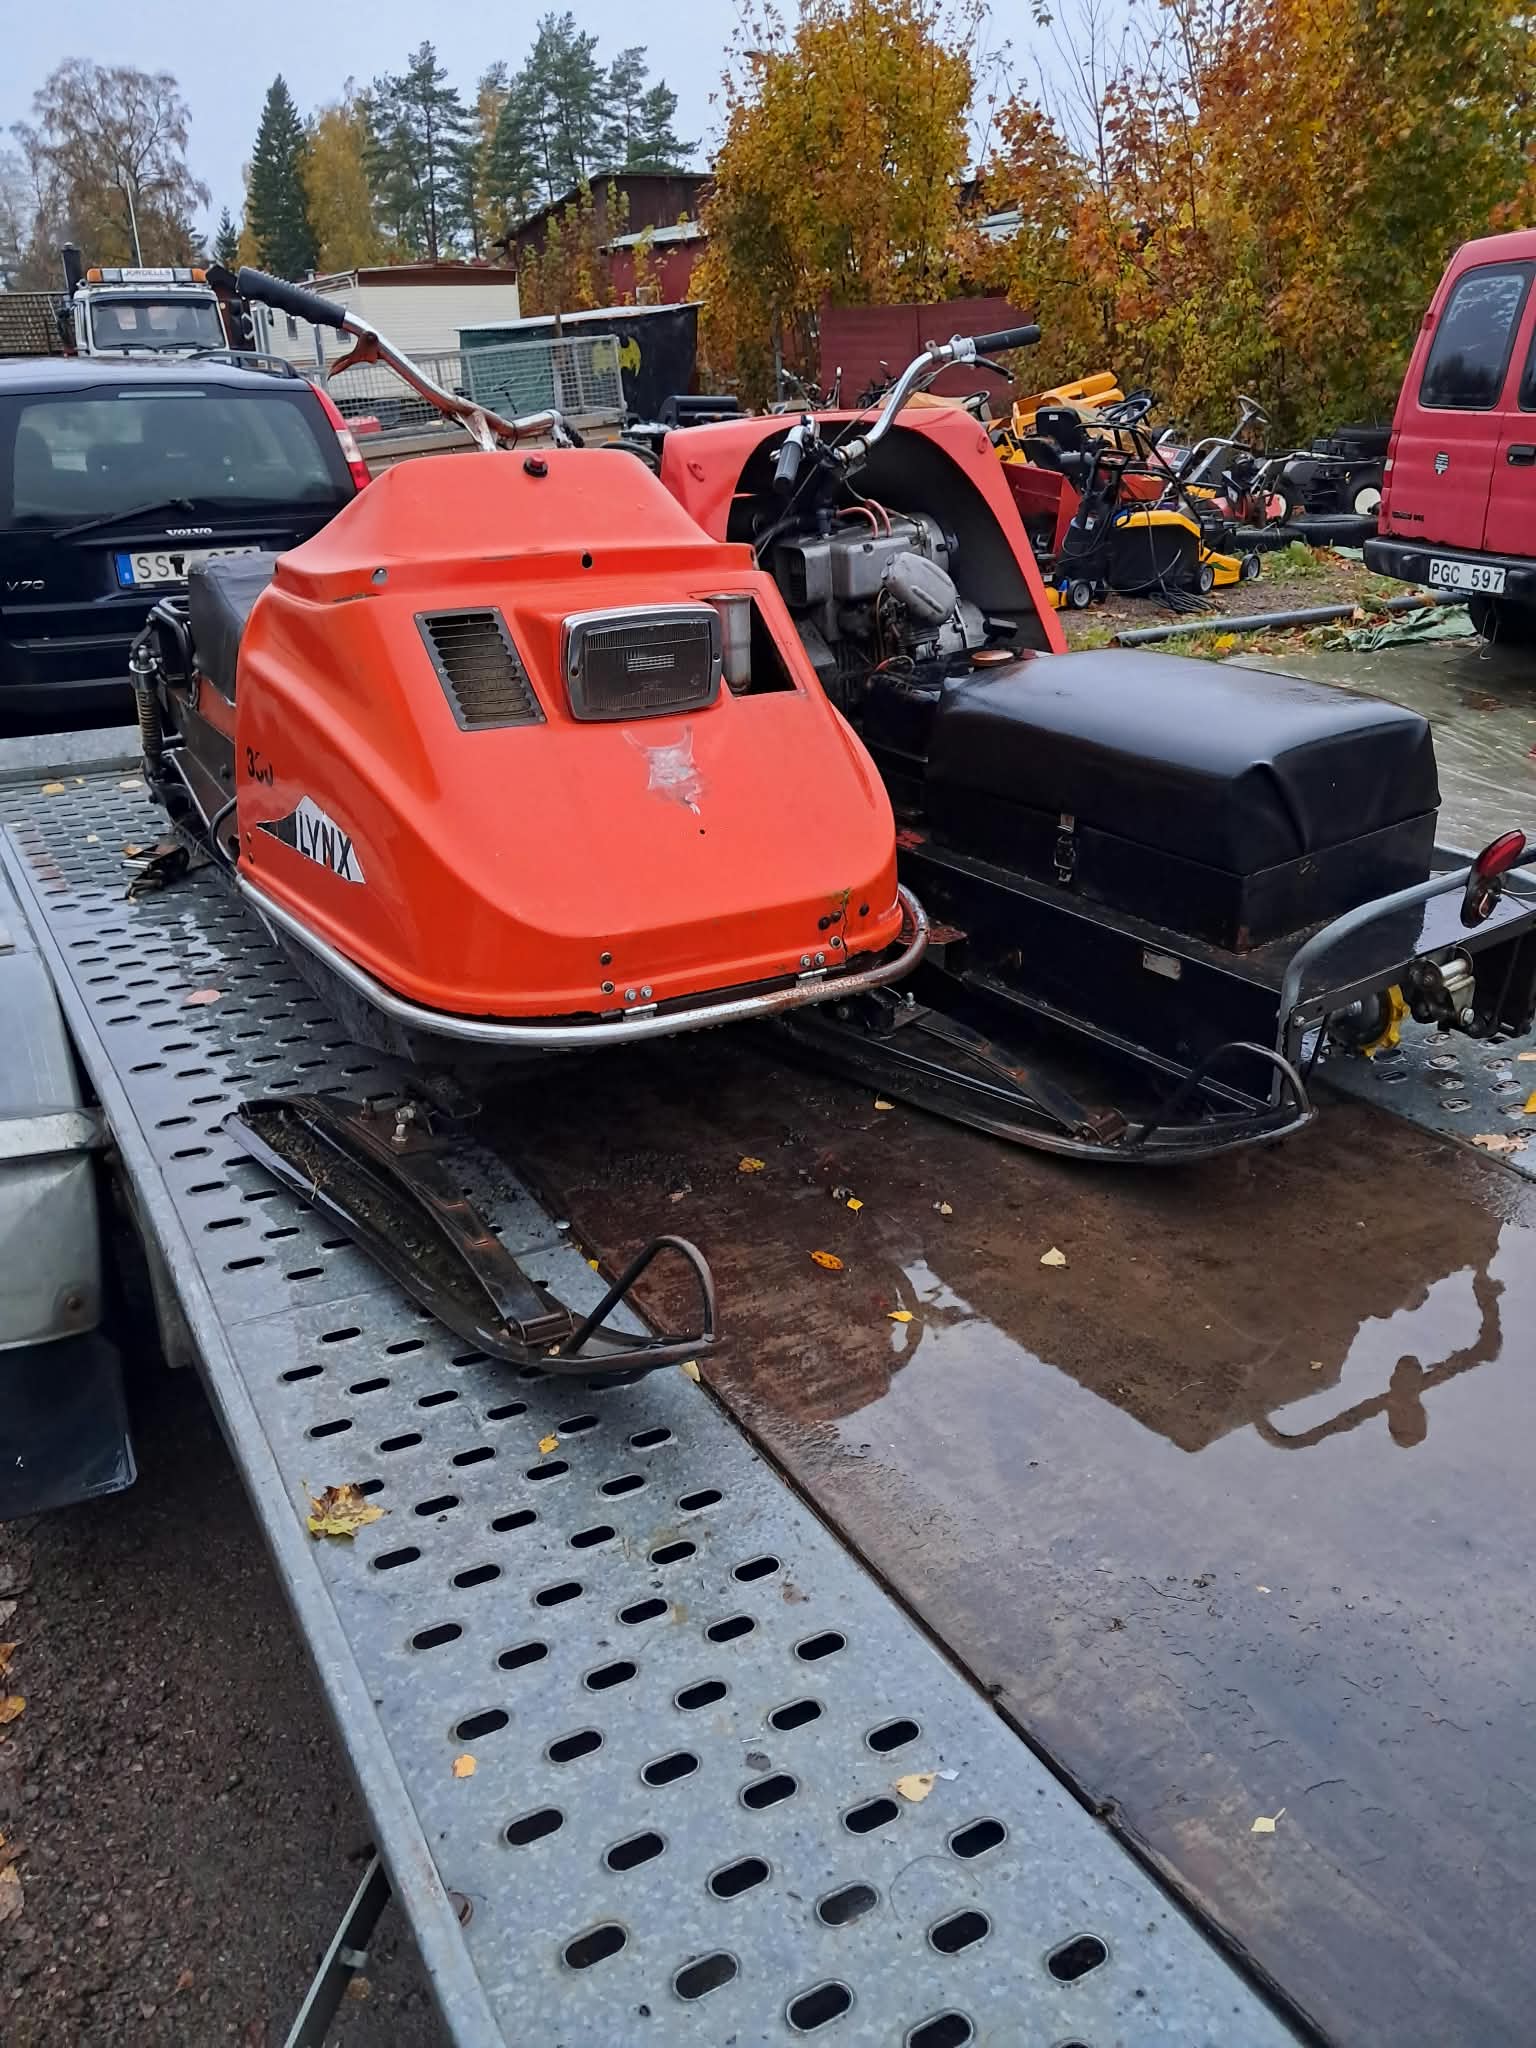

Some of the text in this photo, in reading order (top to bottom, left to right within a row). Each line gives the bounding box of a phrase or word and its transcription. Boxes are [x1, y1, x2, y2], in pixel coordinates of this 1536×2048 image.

[165, 528, 213, 537] VOLVO
[7, 580, 45, 591] V70
[1431, 562, 1504, 591] PGC 597
[299, 811, 352, 881] LYNX
